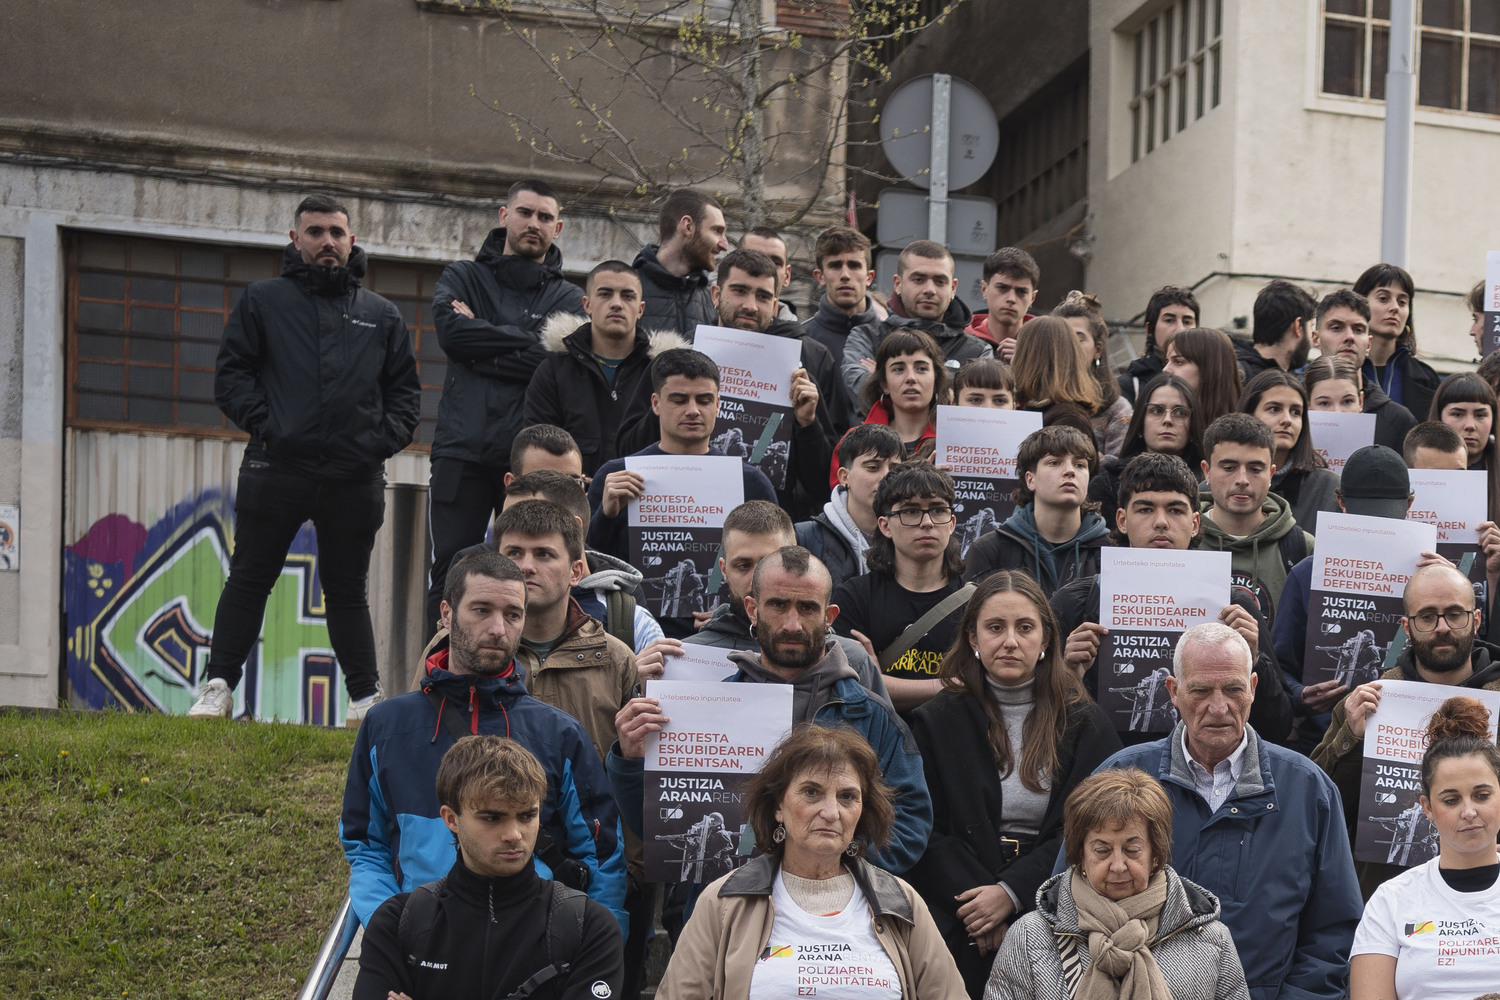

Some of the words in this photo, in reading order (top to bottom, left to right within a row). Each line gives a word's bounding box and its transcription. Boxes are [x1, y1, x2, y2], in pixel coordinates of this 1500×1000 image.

[716, 366, 752, 378] OTESTA
[720, 376, 777, 392] UBIDEAREN
[718, 385, 760, 399] ENTSAN,
[719, 400, 745, 412] TIZIA
[947, 446, 999, 456] PROTESTA
[947, 455, 1017, 467] ESKUBIDEARE
[954, 481, 994, 491] USTIZIA
[639, 495, 695, 504] PROTESTA
[639, 505, 723, 514] ESKUBIDEAREN
[640, 515, 707, 525] DEFENTSAN,
[641, 532, 693, 541] JUSTIZIA
[1325, 557, 1384, 570] PROTESTA
[1323, 579, 1394, 595] DEFENTSAN,
[1113, 594, 1175, 604] PROTESTA
[1322, 597, 1377, 610] JUSTIZIA
[1112, 605, 1206, 617] ESKUBIDEAREN
[1112, 617, 1187, 629] DEFENTSAN,
[1113, 635, 1170, 647] JUSTIZIA
[659, 693, 699, 702] Urtebeteko
[1378, 724, 1426, 738] PROTES
[659, 732, 729, 743] PROTESTA
[1377, 735, 1430, 750] ESKUBID
[658, 744, 765, 757] ESKUBIDEAREN
[1376, 746, 1424, 760] DEFENT
[658, 757, 743, 770] DEFENTSAN,
[1376, 765, 1421, 780] JUSTIZ
[659, 777, 724, 790] JUSTIZIA
[797, 943, 851, 952] JUSTIZIA
[420, 960, 448, 970] AMMUT
[1438, 958, 1455, 966] EZ!
[798, 966, 873, 975] POLIZIAREN
[798, 976, 891, 989] INPUNITATEARI
[798, 987, 817, 996] EZ!
